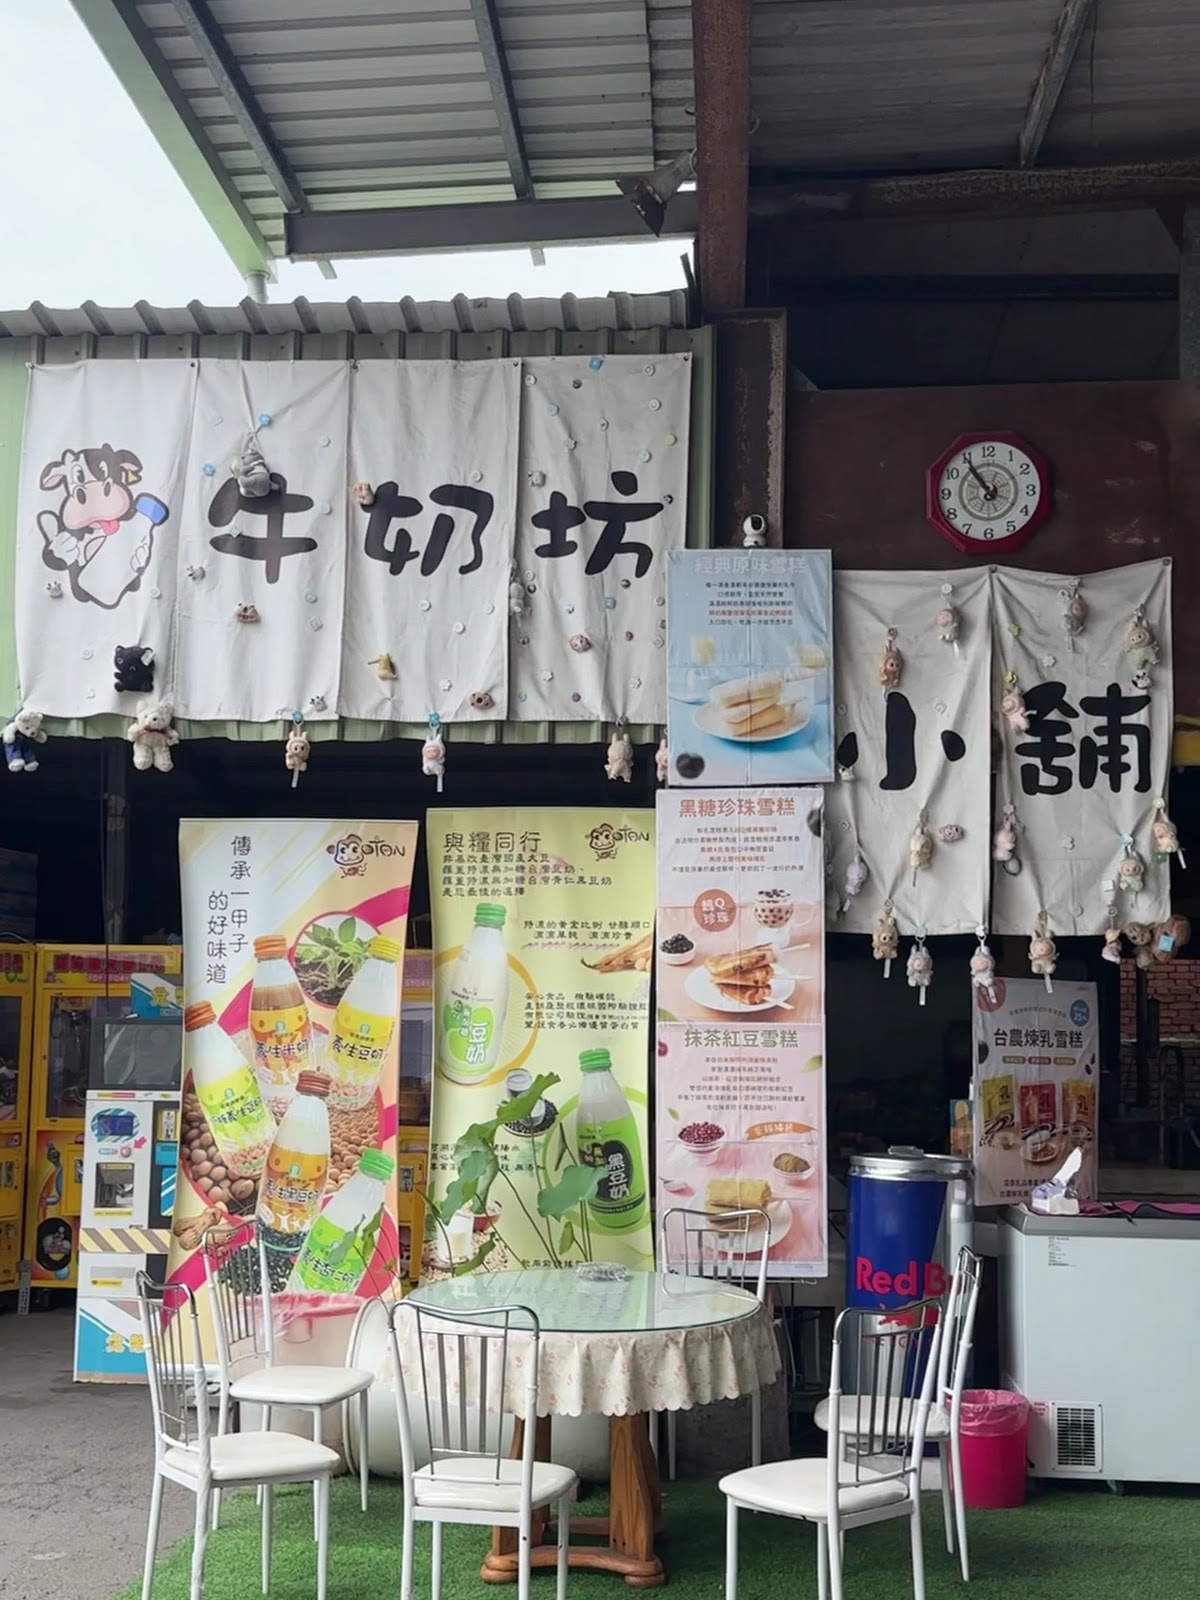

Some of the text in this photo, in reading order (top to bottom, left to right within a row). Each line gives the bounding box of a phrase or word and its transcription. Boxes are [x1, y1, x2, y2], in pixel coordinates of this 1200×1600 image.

[981, 445, 996, 458] 12
[1008, 450, 1014, 462] 1
[946, 467, 959, 480] 10
[1019, 463, 1030, 475] 2
[941, 488, 951, 500] 9
[1026, 484, 1036, 496] 3
[946, 508, 957, 520] 8
[1019, 504, 1029, 516] 4
[208, 470, 667, 584] 牛奶坊
[962, 523, 972, 535] 7
[983, 528, 994, 540] 6
[1006, 520, 1016, 532] 5
[695, 556, 808, 575] 經典原味雪糕
[679, 798, 796, 818] 黑糖珍珠雪糕
[443, 831, 541, 853] 與糧同行
[229, 835, 251, 953] 傳承一甲子
[206, 891, 228, 984] 的好味道
[466, 1022, 487, 1065] 豆奶
[684, 1029, 798, 1049] 抹茶紅豆雪糕
[994, 1028, 1084, 1050] 台農煉乳雪糕
[607, 1152, 630, 1200] 黑豆奶
[856, 1256, 918, 1297] Red
